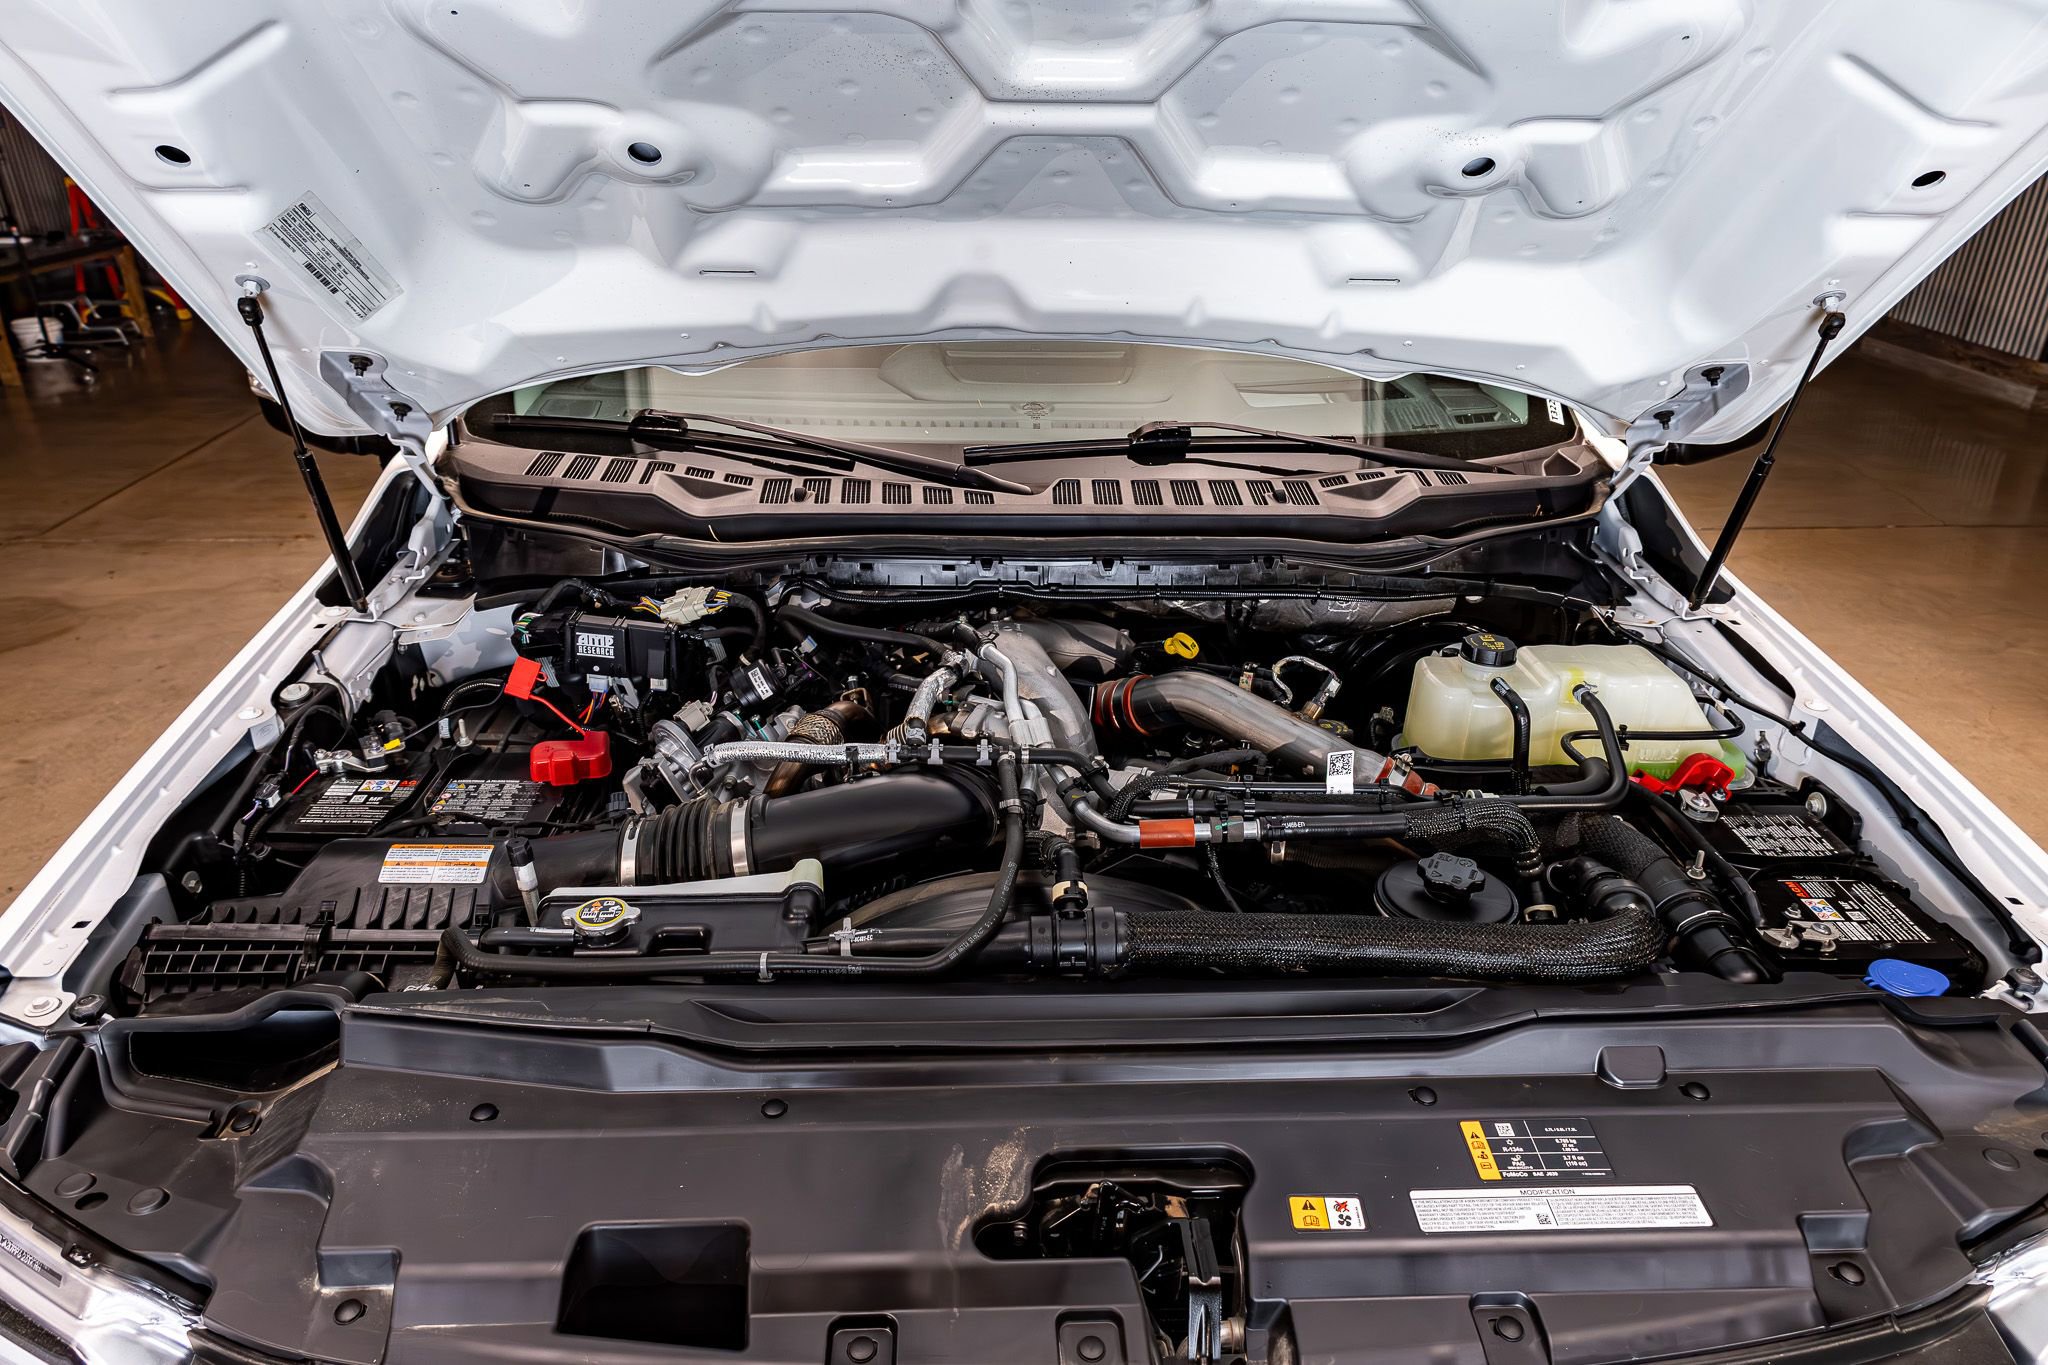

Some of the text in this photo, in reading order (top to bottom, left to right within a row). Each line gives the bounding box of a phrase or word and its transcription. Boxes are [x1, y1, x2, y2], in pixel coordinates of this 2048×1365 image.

[577, 633, 615, 648] AMP
[578, 646, 614, 656] RESEARCH
[1784, 881, 1807, 898] AGM
[1519, 1188, 1575, 1196] MODIFICATION
